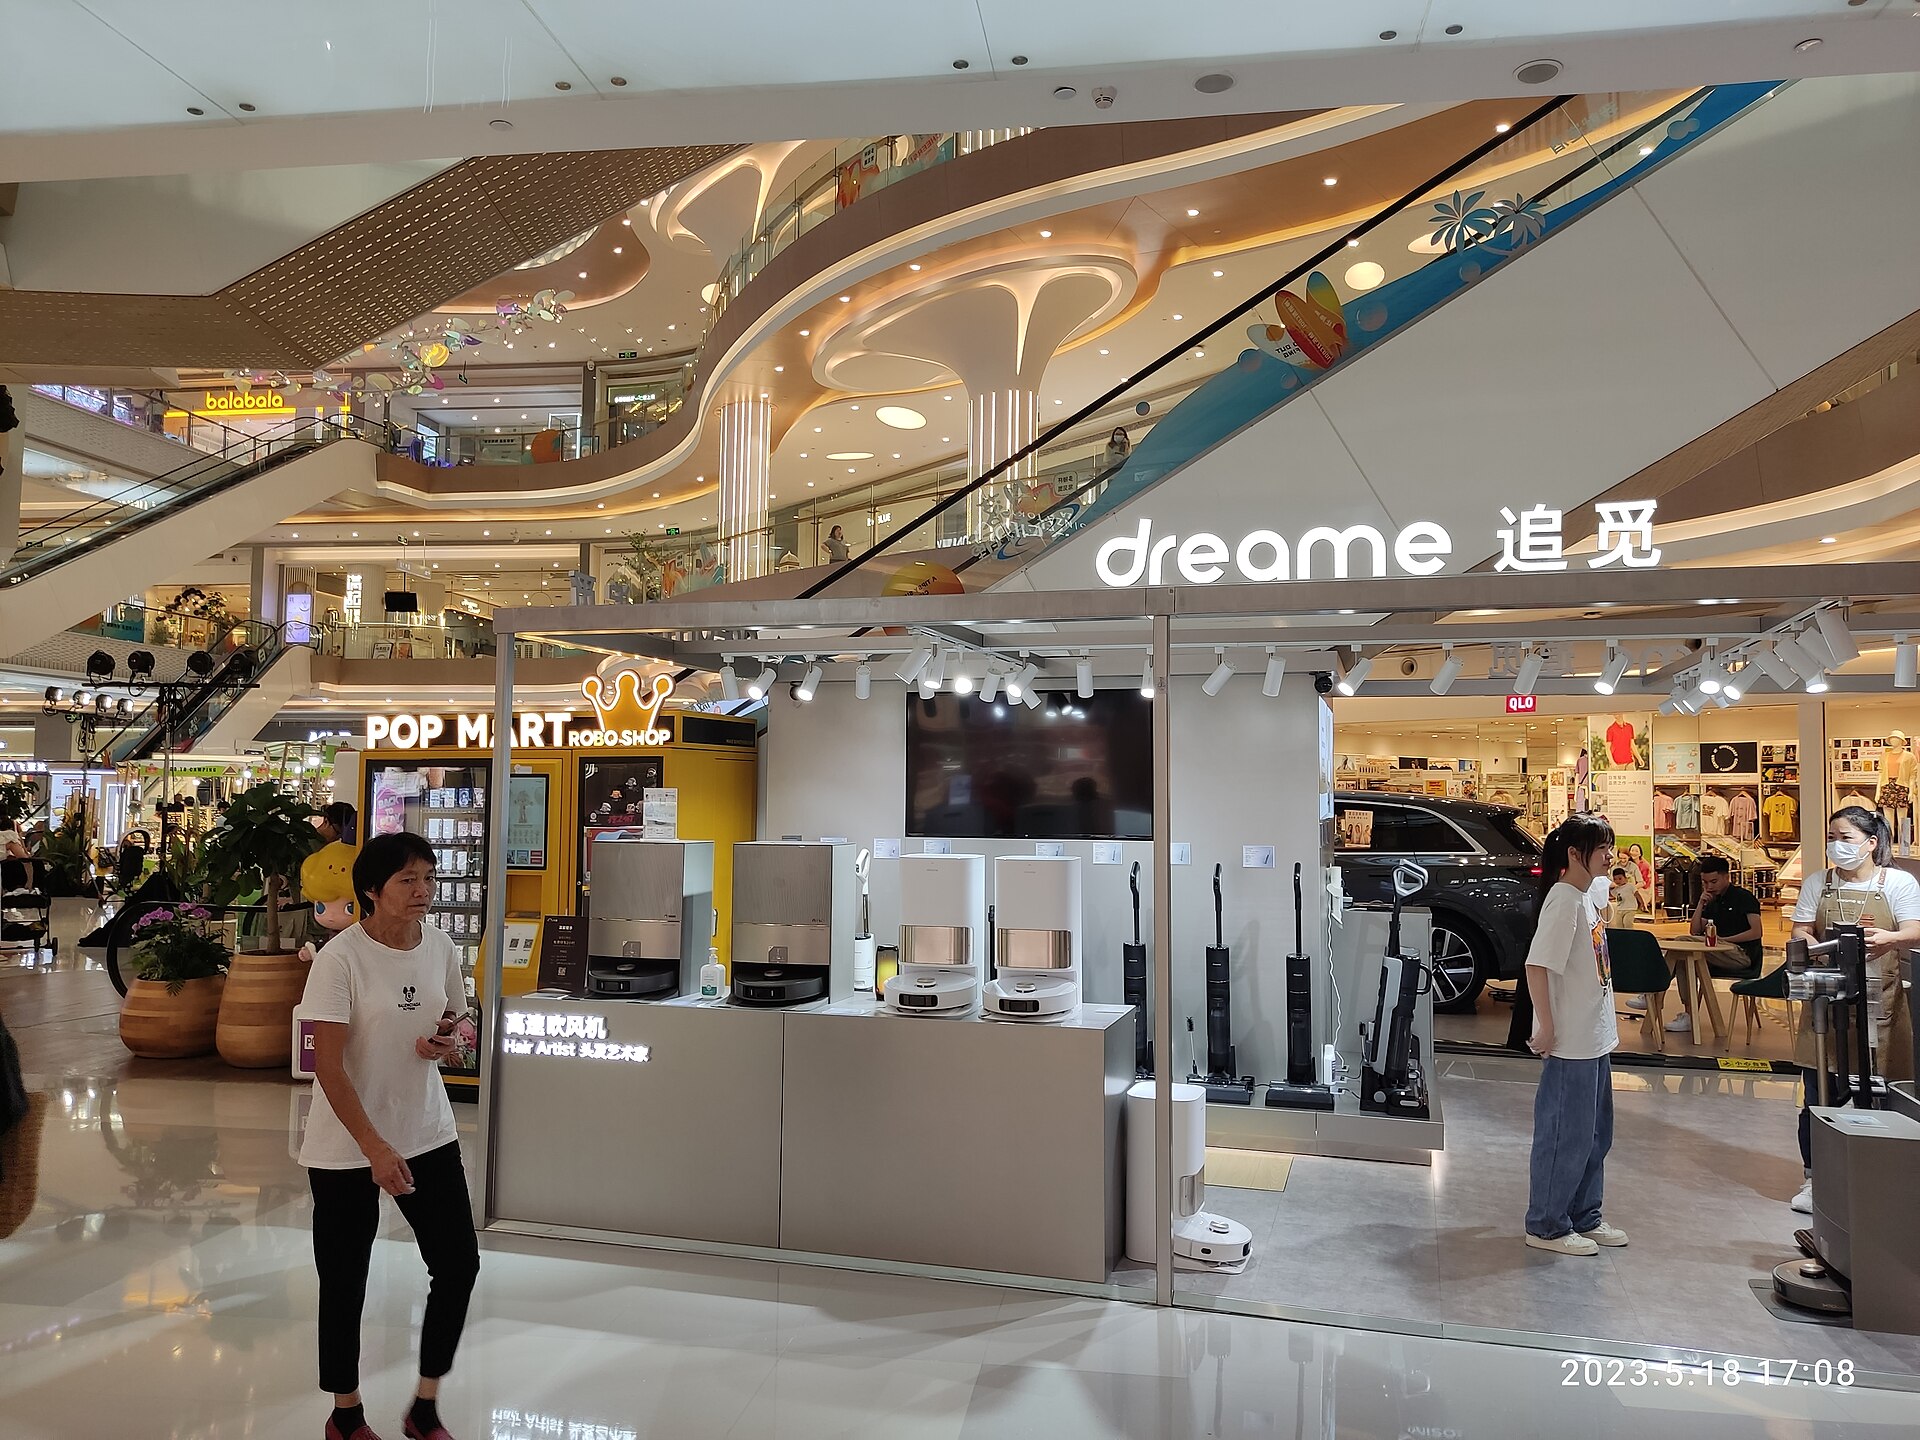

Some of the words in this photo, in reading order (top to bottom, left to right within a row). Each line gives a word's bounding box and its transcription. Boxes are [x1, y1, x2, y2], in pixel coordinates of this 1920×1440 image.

[206, 390, 284, 410] balabala
[1494, 499, 1662, 573] 追觅
[1095, 518, 1452, 588] dreame
[1508, 696, 1534, 709] QLO
[366, 714, 443, 749] POP
[504, 1011, 609, 1040] 高速吹风机
[503, 1038, 535, 1055] Hair
[536, 1040, 577, 1058] Artist
